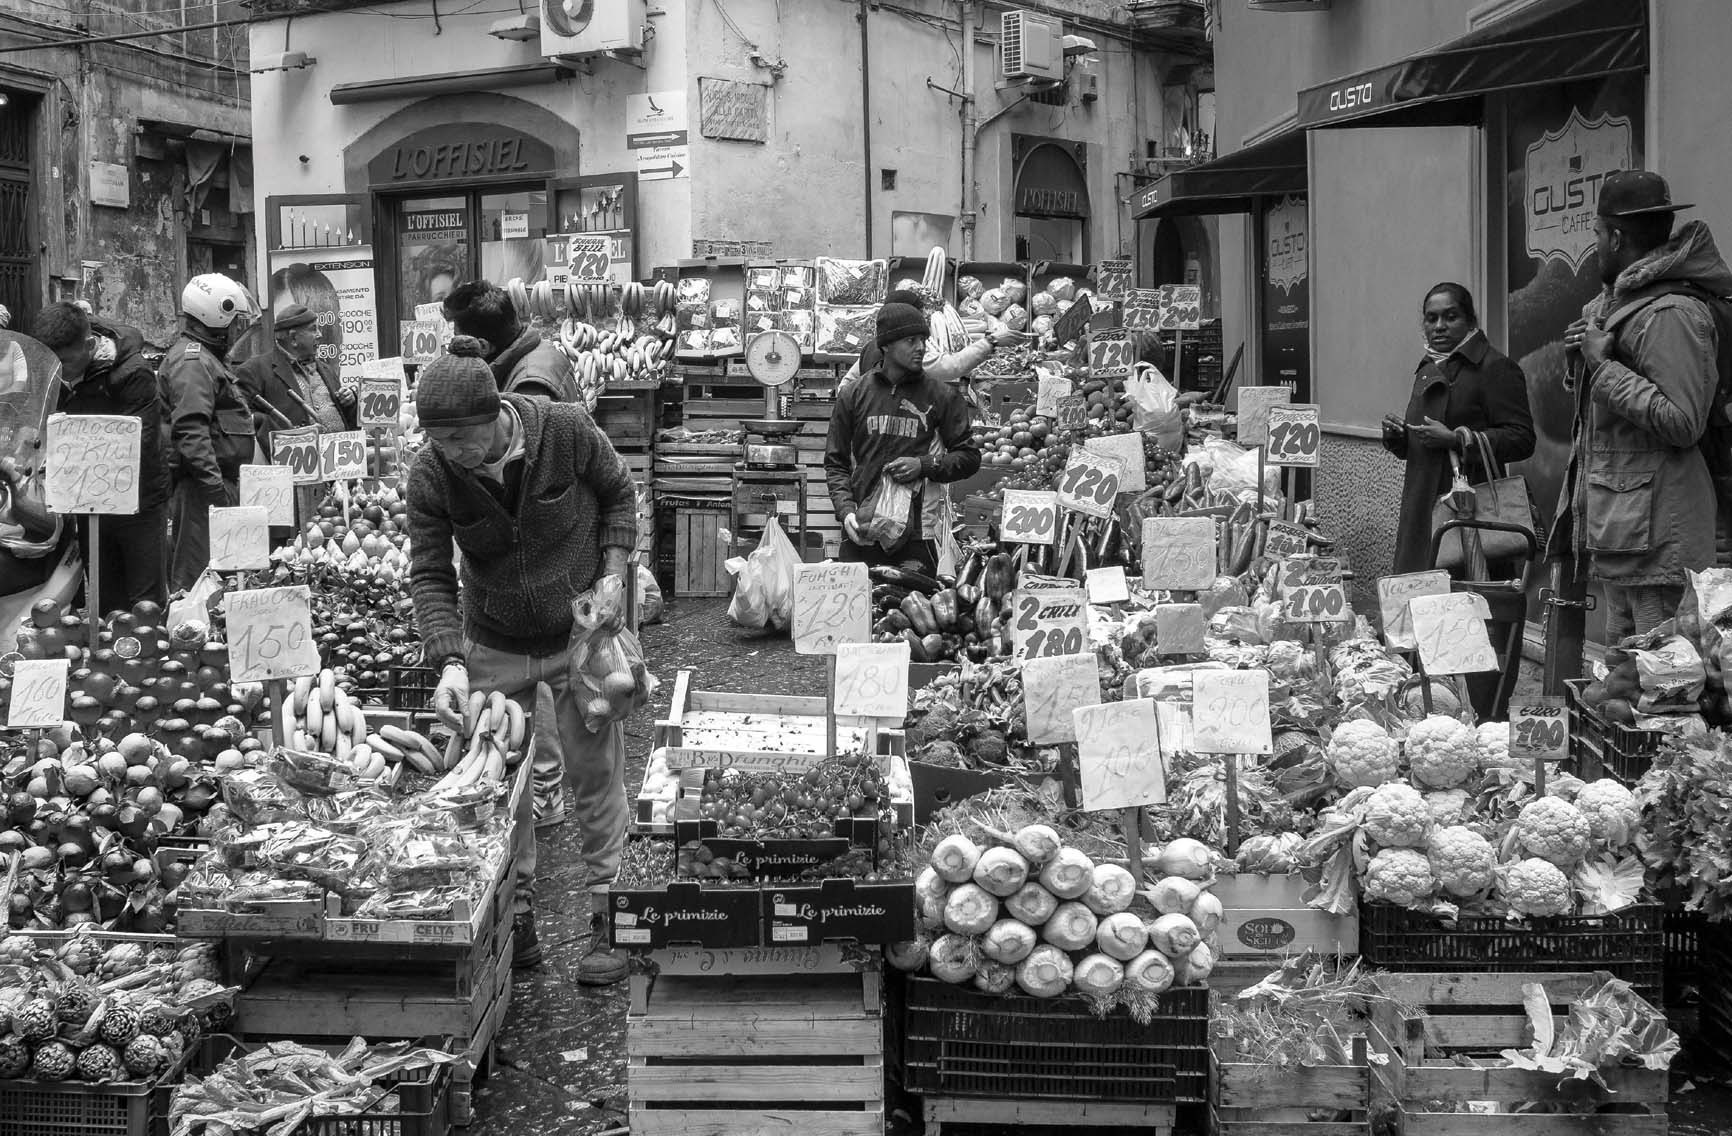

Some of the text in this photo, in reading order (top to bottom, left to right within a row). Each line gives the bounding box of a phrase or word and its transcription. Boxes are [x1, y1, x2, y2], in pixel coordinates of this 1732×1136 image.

[1330, 82, 1372, 111] GUSTO
[392, 138, 529, 179] L'OFFISIEL
[1534, 171, 1620, 215] GUST
[406, 213, 463, 230] L'OFFISIEL
[314, 261, 370, 270] EXTENSION
[1126, 290, 1138, 309] 2
[339, 310, 372, 318] CIOCCHE
[340, 343, 373, 351] CIOCCHE
[1284, 561, 1305, 587] 2
[1016, 596, 1040, 631] 2
[734, 850, 818, 870] Le primizie
[639, 907, 732, 927] Le primizie
[796, 903, 885, 923] Le primizie
